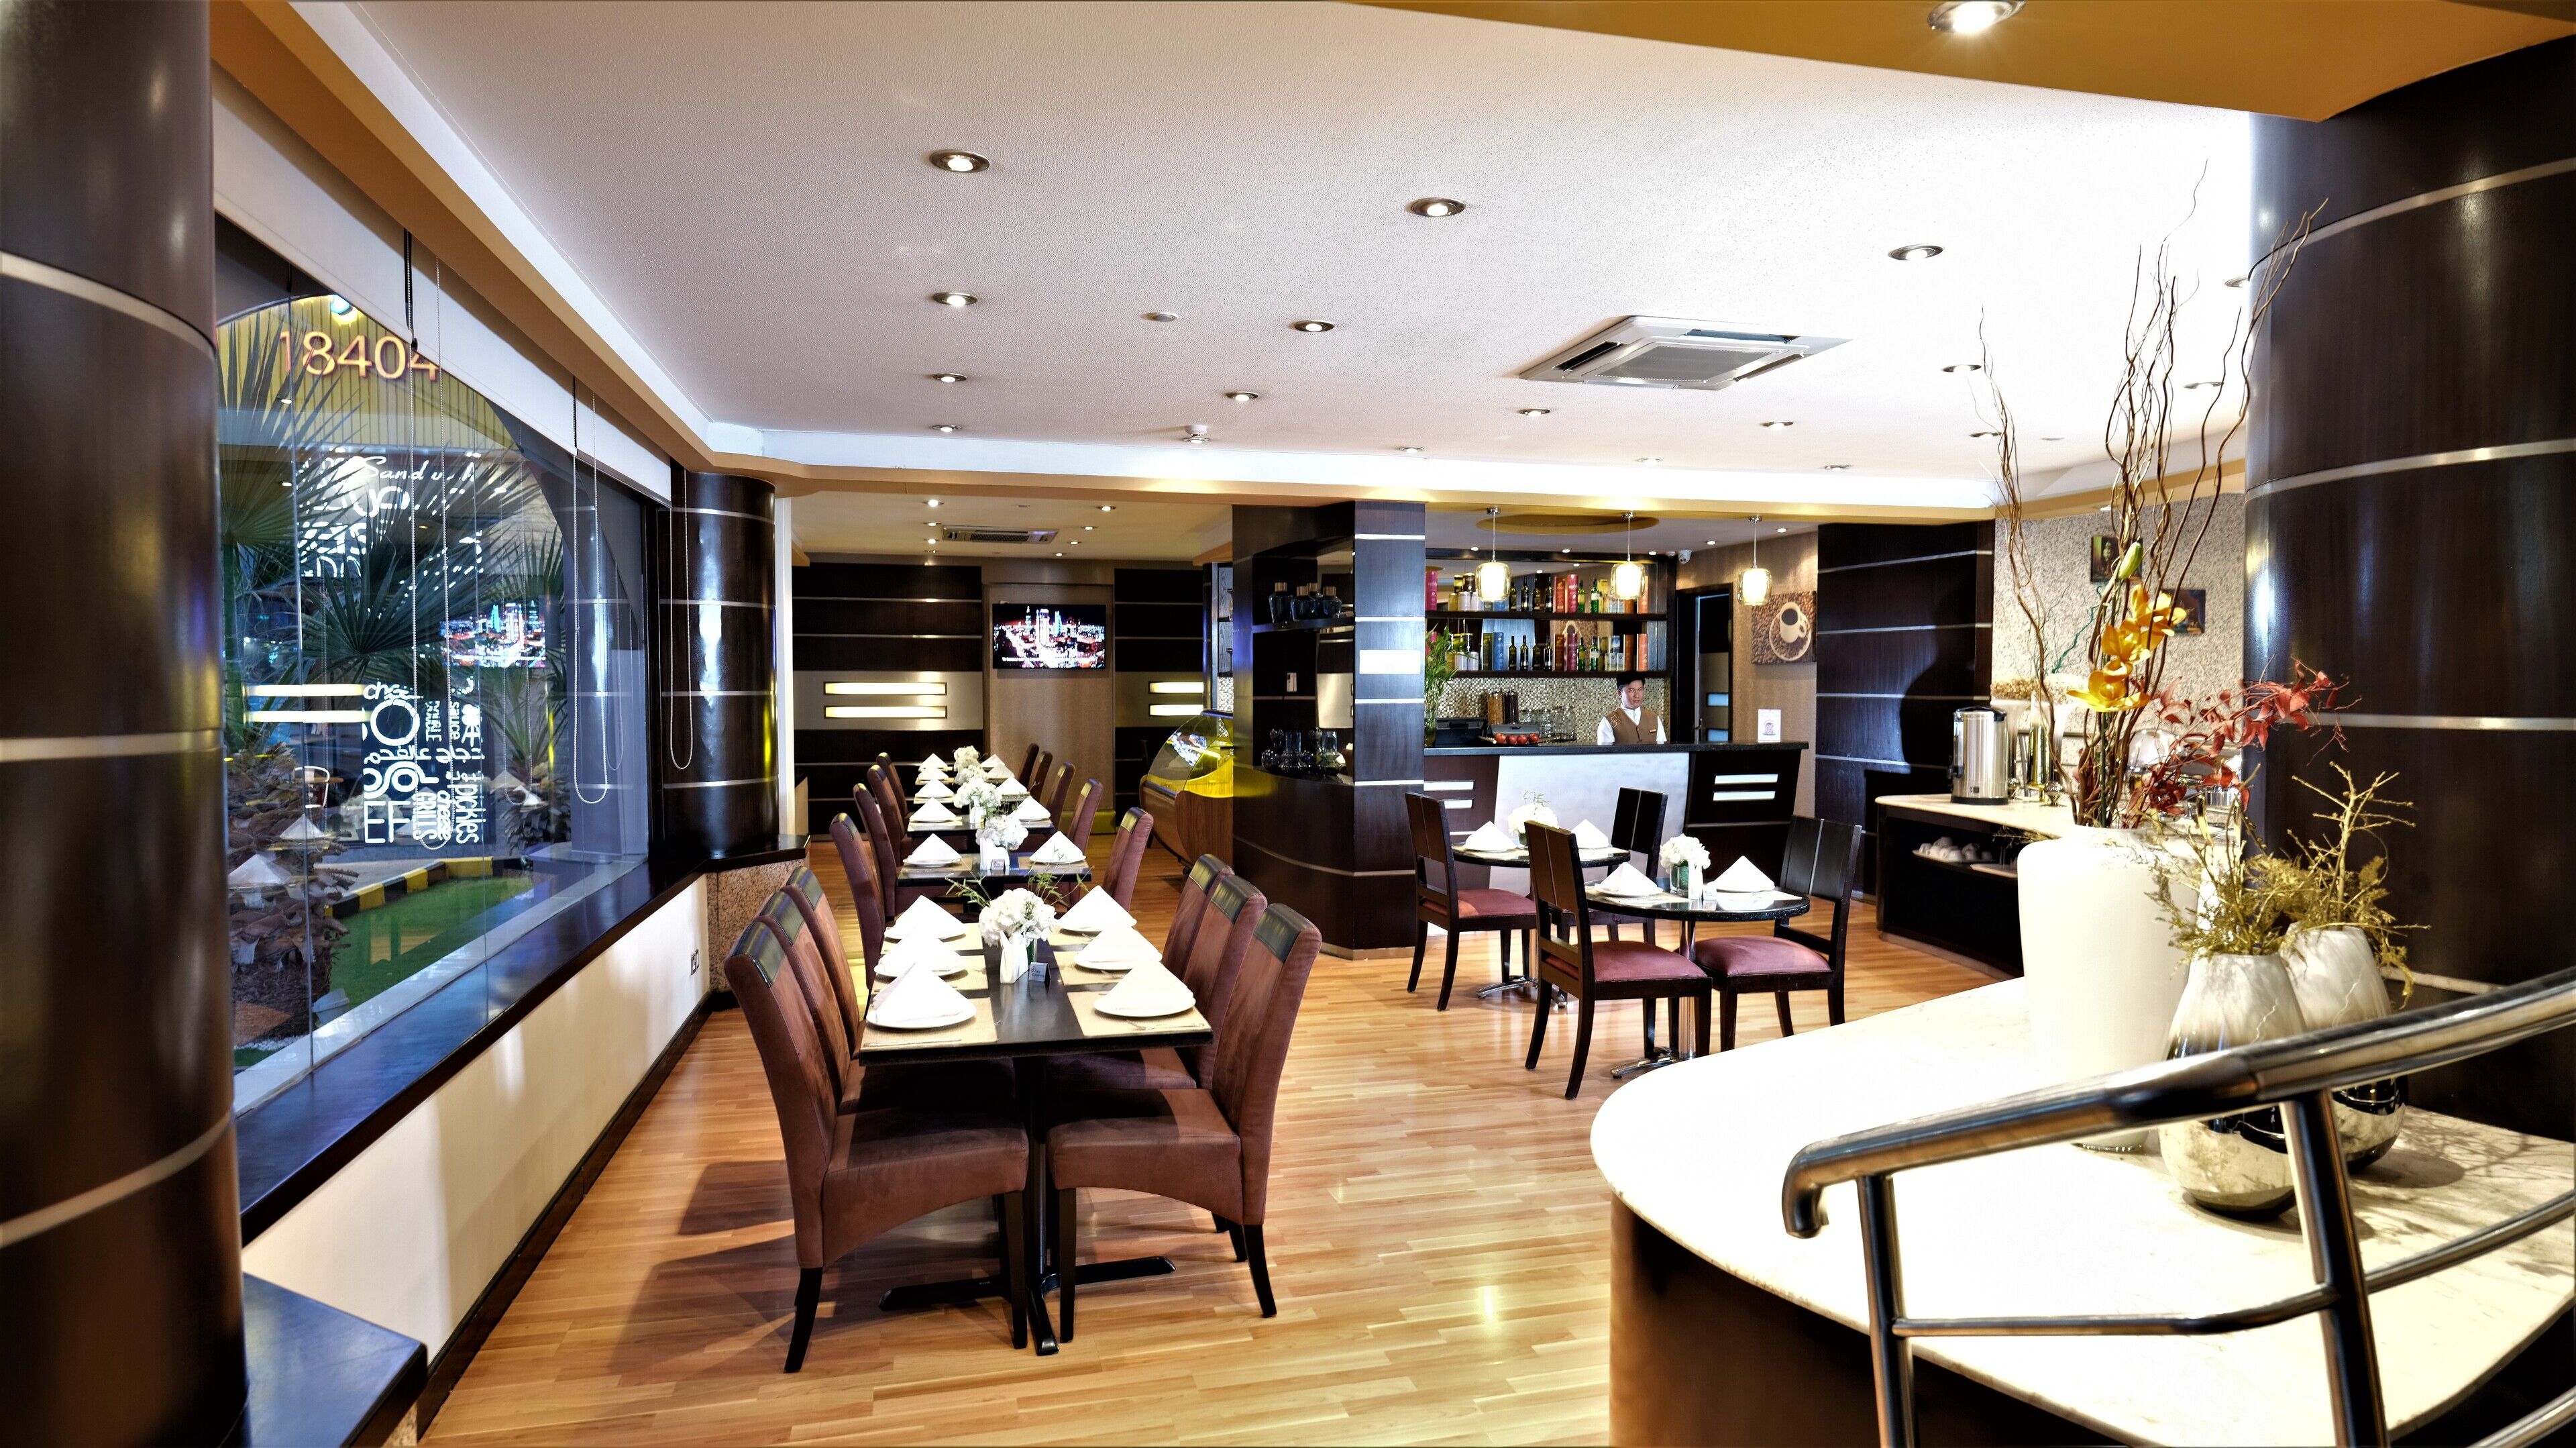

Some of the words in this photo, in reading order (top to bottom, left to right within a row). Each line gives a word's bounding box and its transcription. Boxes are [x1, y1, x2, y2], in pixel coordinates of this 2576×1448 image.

[280, 330, 441, 381] 18404
[449, 701, 461, 740] sauce
[412, 792, 438, 841] GRILLS
[437, 790, 453, 841] cheese
[447, 784, 486, 844] pickles
